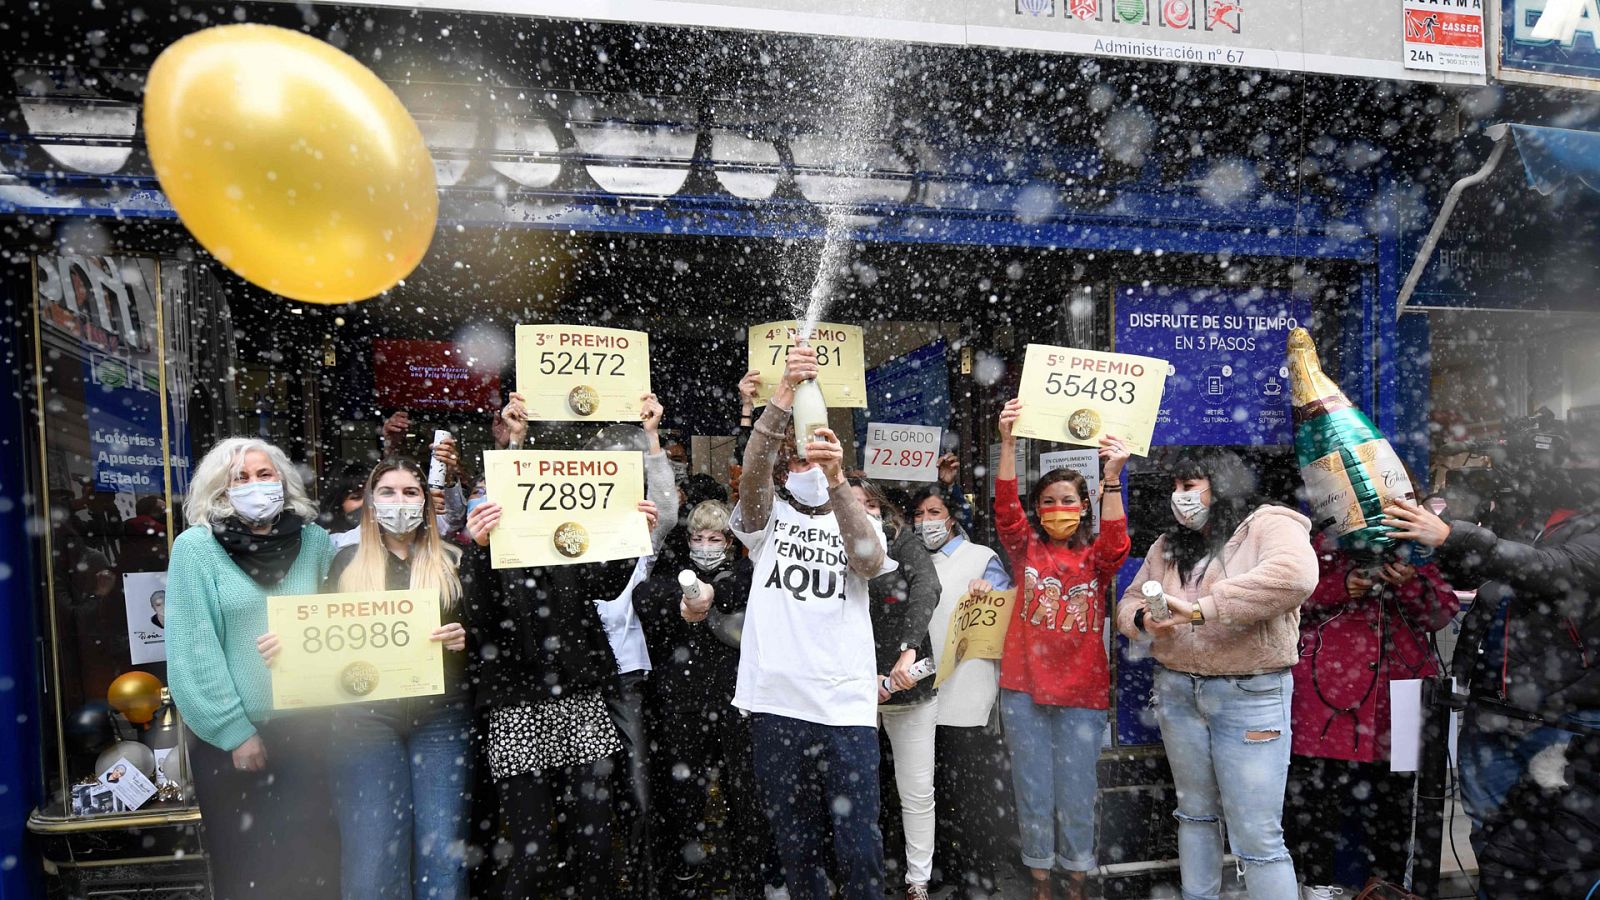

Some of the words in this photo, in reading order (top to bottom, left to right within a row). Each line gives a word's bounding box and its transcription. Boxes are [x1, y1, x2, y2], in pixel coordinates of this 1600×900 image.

[1094, 39, 1203, 60] Administración
[1208, 50, 1222, 61] nº
[1226, 49, 1245, 64] 67
[1410, 50, 1434, 63] 24h
[1129, 313, 1199, 329] DISFRUTE
[1202, 315, 1220, 329] DE
[1223, 316, 1243, 330] SU
[1247, 316, 1298, 331] TIEMPO
[536, 333, 554, 346] 3er
[560, 333, 629, 349] PREMIO
[765, 328, 782, 341] 4º
[786, 328, 847, 343] PEMIO
[1175, 336, 1194, 350] EN
[1197, 336, 1206, 350] 3
[1209, 336, 1256, 351] PASOS
[540, 351, 625, 376] 52472
[768, 344, 842, 367] 781
[1046, 354, 1065, 367] 5º
[1070, 356, 1145, 377] PREMIO
[1045, 372, 1136, 405] 55483
[95, 430, 155, 447] Loterías
[874, 429, 887, 441] EL
[891, 430, 934, 444] GORDO
[98, 450, 164, 467] Apuestas
[870, 447, 936, 469] 72.897
[513, 460, 531, 476] 1er
[539, 460, 619, 476] PREMIO
[99, 471, 150, 486] Estado
[517, 482, 615, 511] 72897
[297, 604, 319, 621] 5º
[327, 599, 413, 619] PREMIO
[958, 595, 1006, 611] PREMIO
[302, 621, 410, 654] 86986
